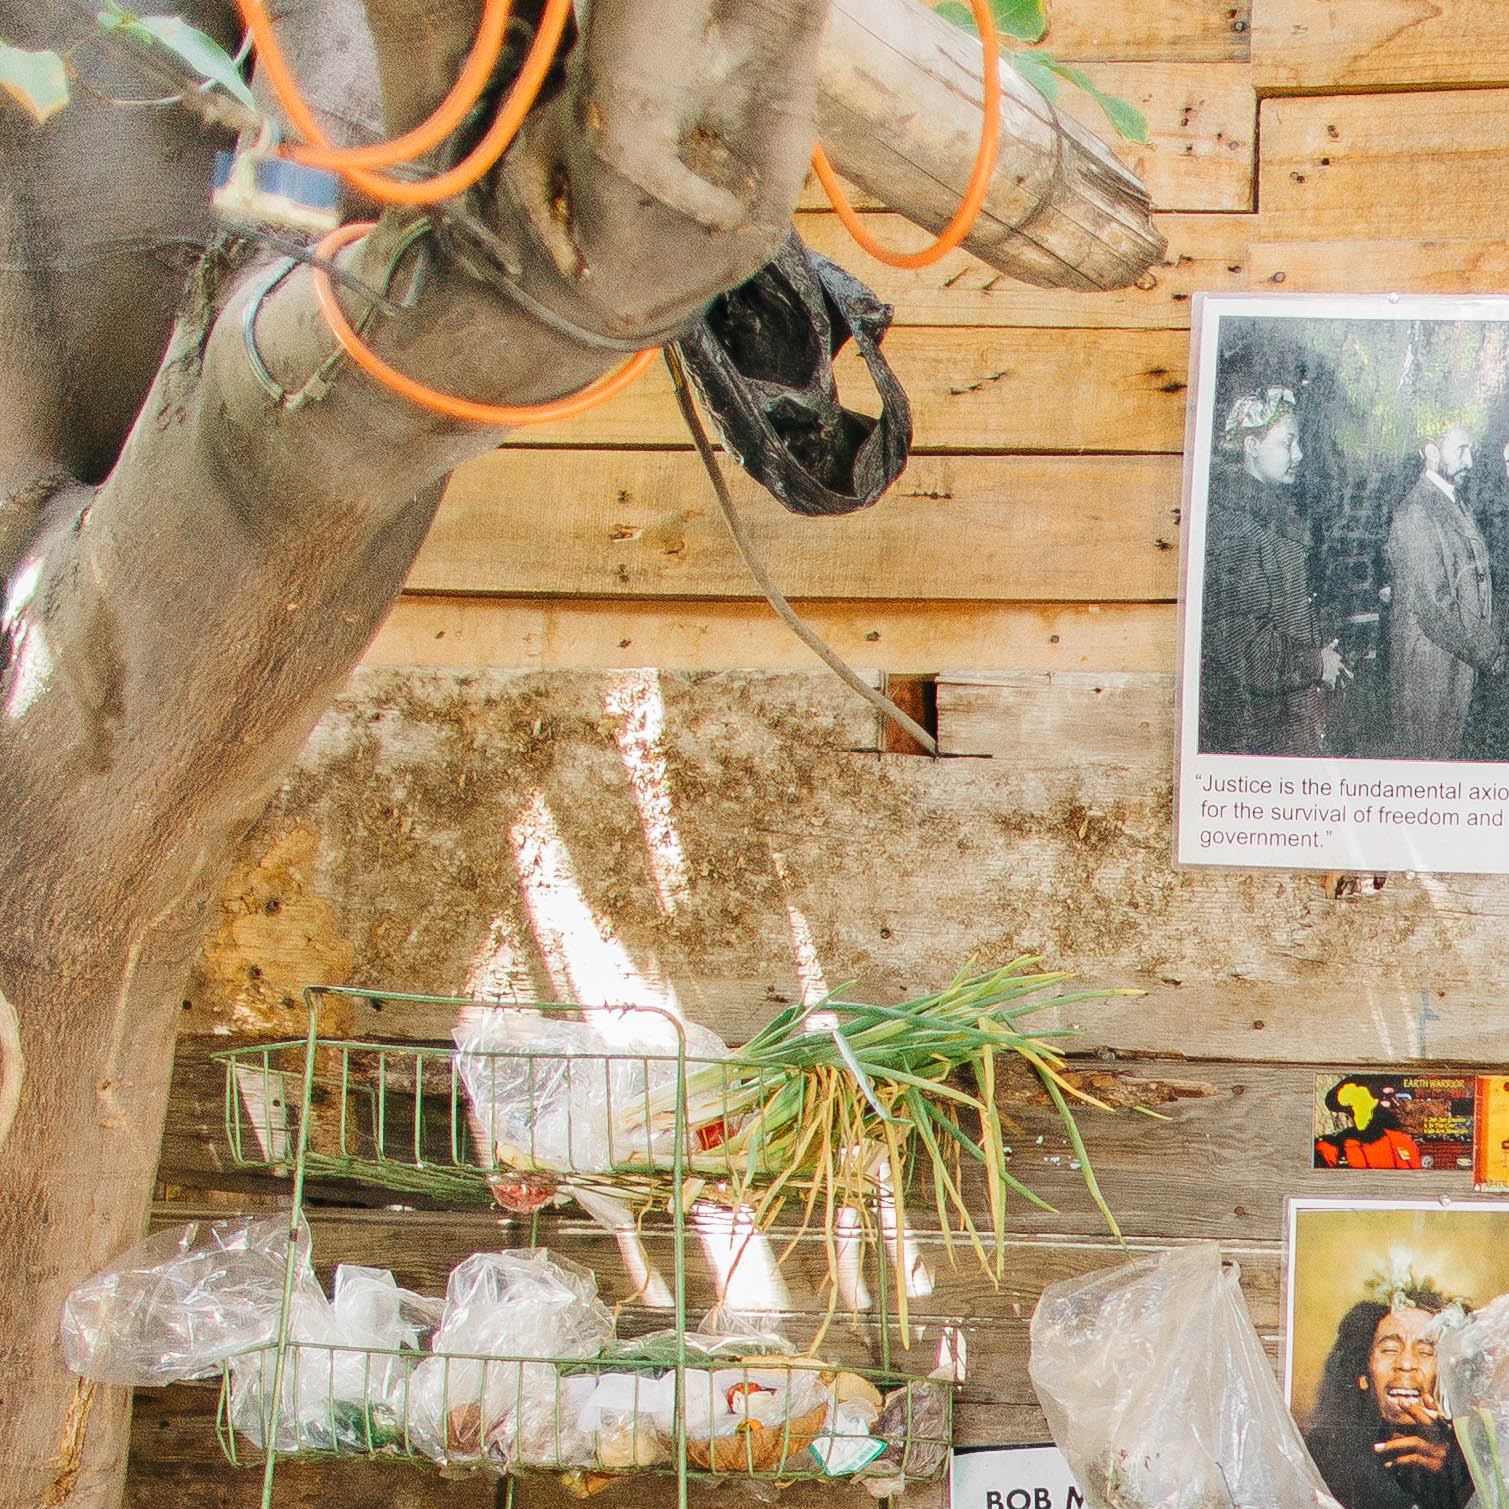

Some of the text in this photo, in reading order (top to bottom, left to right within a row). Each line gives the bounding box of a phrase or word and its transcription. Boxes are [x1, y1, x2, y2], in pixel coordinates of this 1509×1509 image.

[1195, 774, 1272, 794] “Justice
[1279, 777, 1294, 794] is
[1302, 777, 1332, 796] the
[1339, 778, 1461, 800] fundamental
[1200, 800, 1503, 827] for the survival of freedom and
[1200, 828, 1333, 849] government.”
[1403, 1079, 1428, 1088] EARTH
